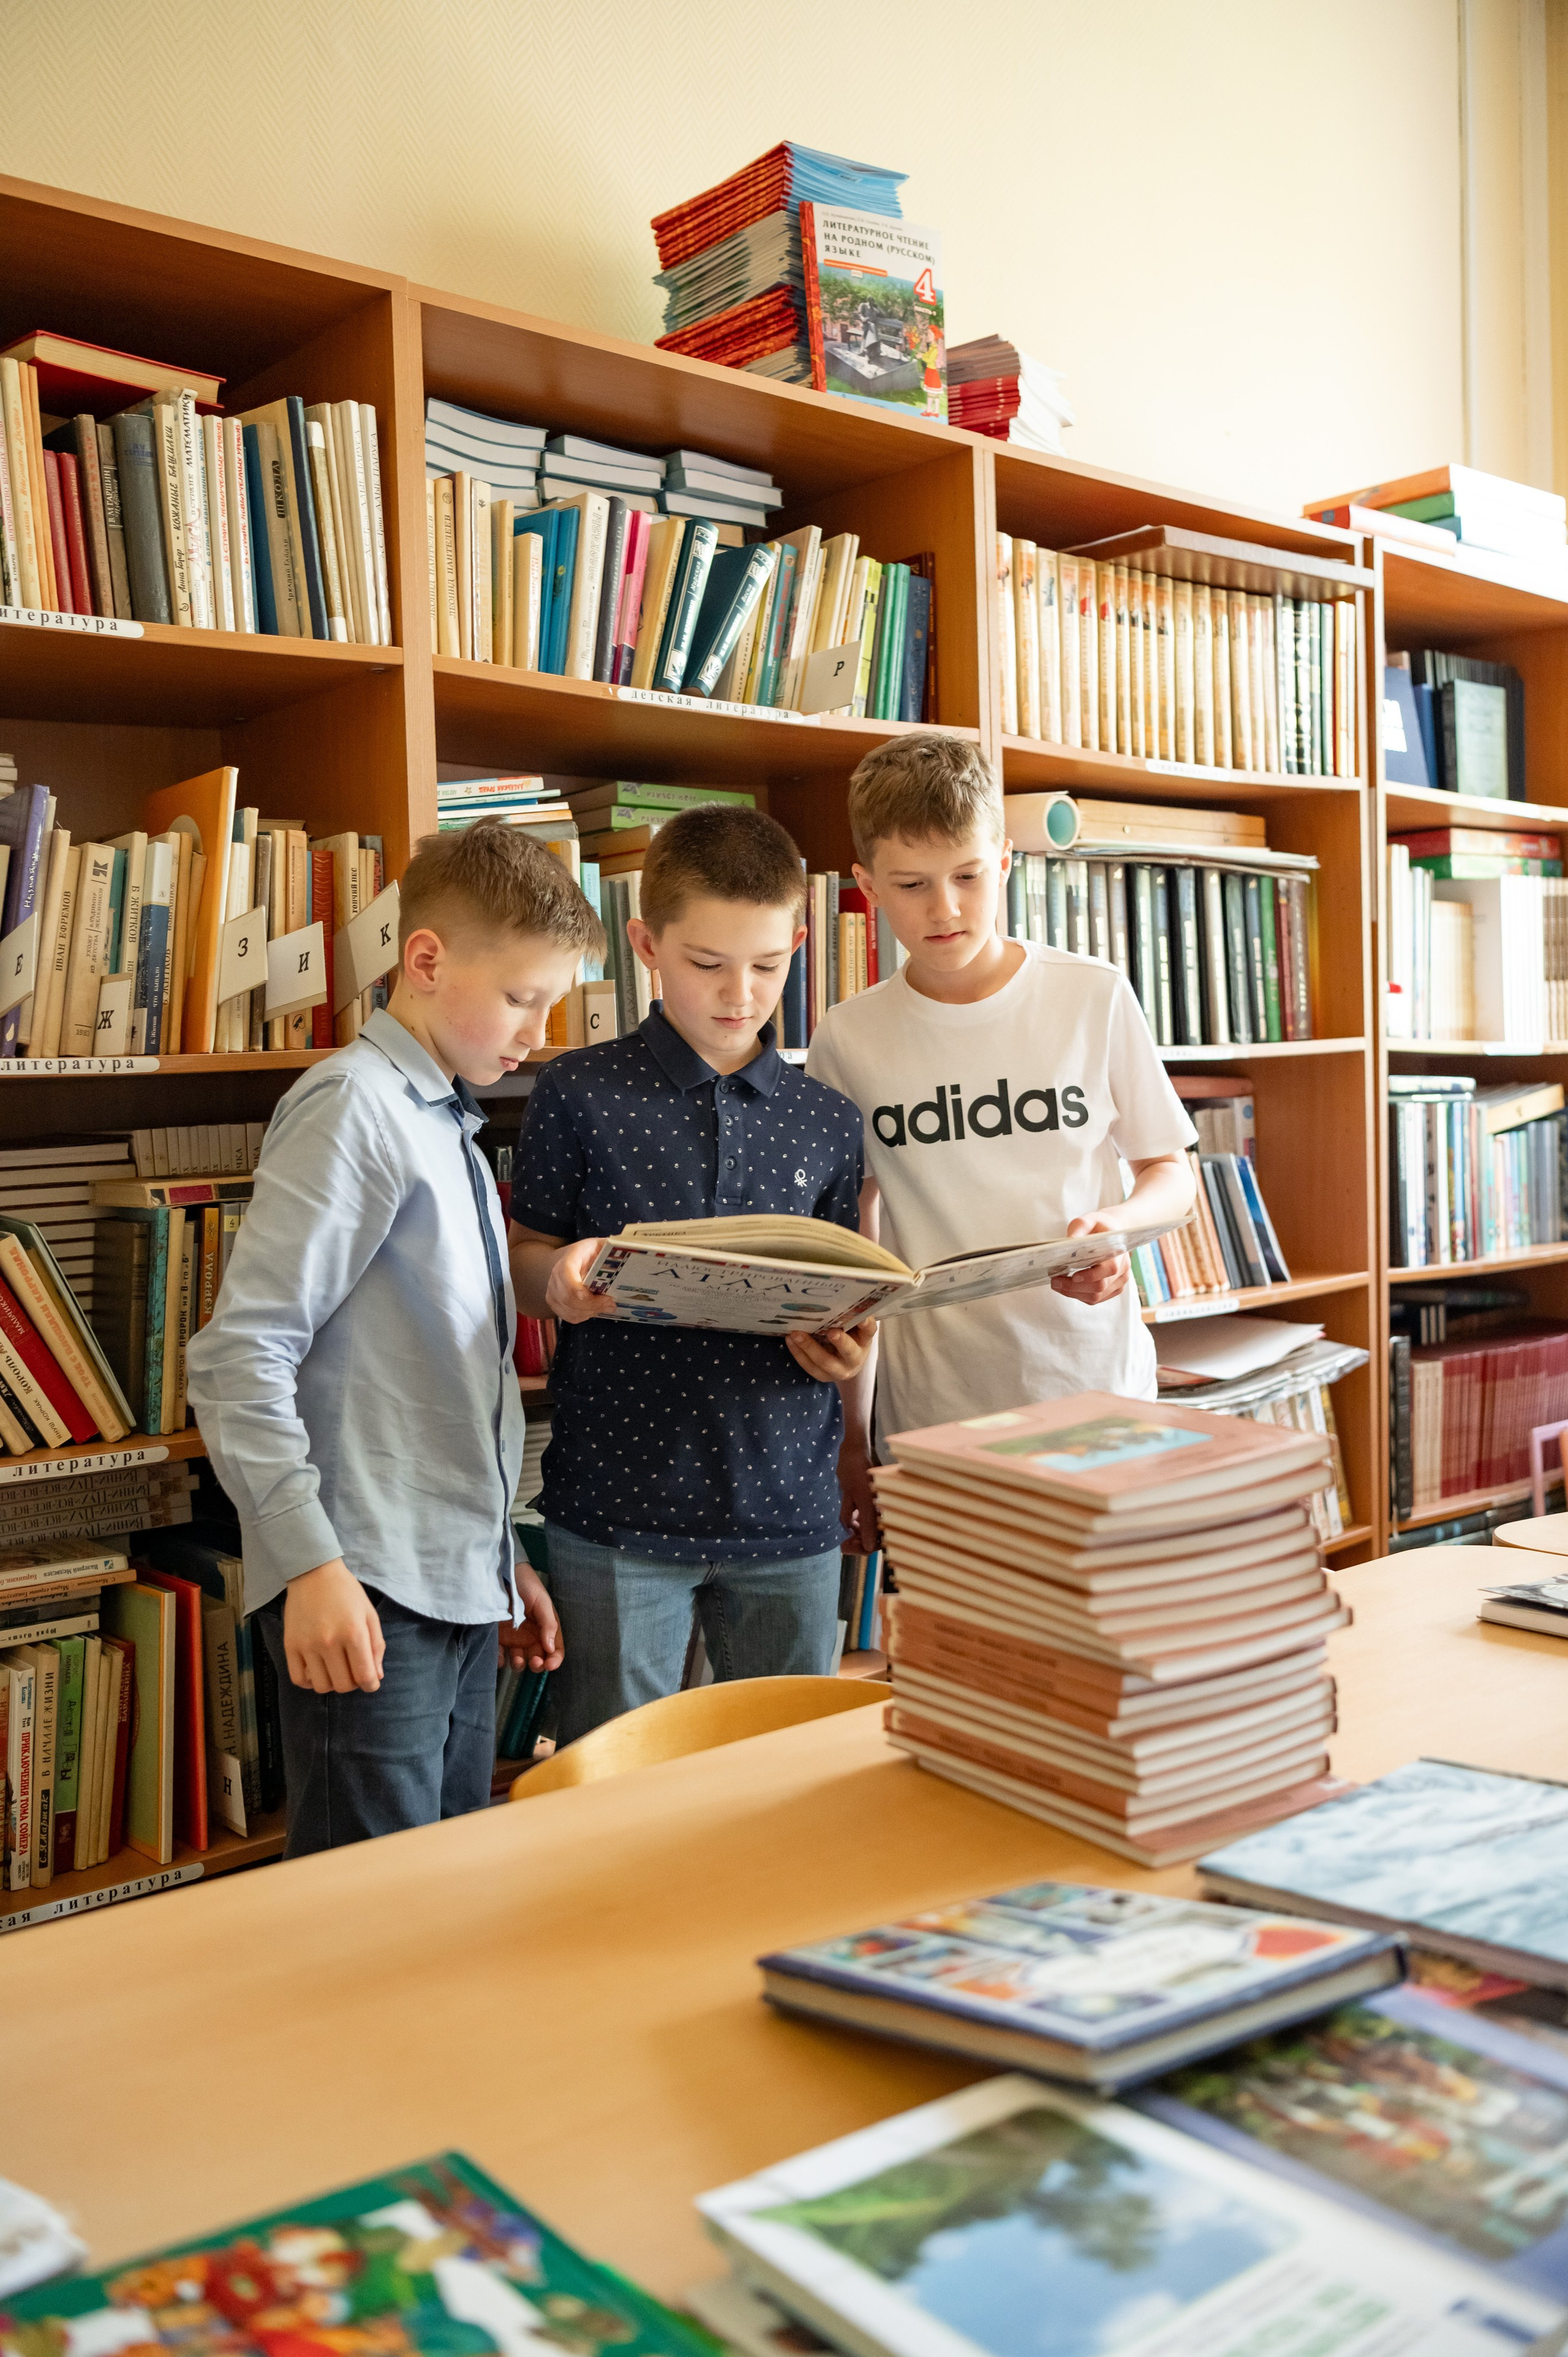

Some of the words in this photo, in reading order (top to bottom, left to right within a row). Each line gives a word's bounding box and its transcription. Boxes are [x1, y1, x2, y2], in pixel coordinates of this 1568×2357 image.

[823, 221, 894, 241] ЛИТЕРАТУРНОЕ
[897, 235, 929, 250] ЧТЕНИЕ
[824, 232, 837, 241] НА
[842, 235, 883, 250] РОДНОМ
[887, 246, 935, 265] (РУССКОМ)
[825, 245, 861, 257] ЯЗЫКЕ
[914, 268, 937, 305] 4
[181, 393, 194, 468] МАТЕМАТИКИ
[164, 426, 177, 478] БАШМАКИ
[355, 430, 364, 475] ПАРУСА
[370, 432, 380, 475] ПАРУСА
[104, 469, 114, 505] ГАРШИН
[273, 463, 285, 518] ШКОЛА
[170, 483, 181, 532] КОЖАНЫЕ
[176, 549, 185, 571] Гарф
[445, 515, 453, 575] ПАНТЕЛЕЕВ
[588, 512, 602, 583] РАССКАЗЫ
[178, 571, 186, 593] Анна
[690, 561, 701, 591] Мирская
[447, 579, 456, 619] ЛЕОНИД
[833, 661, 844, 676] Р
[631, 690, 692, 706] детская
[706, 700, 789, 720] литература
[132, 885, 140, 899] Б.
[59, 891, 71, 937] ЕФРЕМОВ
[129, 901, 139, 943] ЖИТКОВ
[238, 937, 249, 957] З
[380, 922, 391, 947] К
[15, 953, 23, 976] Е
[55, 938, 66, 971] ИВАН
[298, 951, 311, 973] И
[97, 1010, 115, 1030] Ж
[590, 1013, 599, 1030] С
[1, 1058, 134, 1073] литература
[872, 1078, 1088, 1148] adidas
[9, 1246, 45, 1303] КАРРОНАД
[203, 1251, 215, 1314] КЭРРОЛЛ
[649, 1268, 840, 1297] АТЛАС
[1, 1298, 26, 1335] МАЛЬЧИК
[179, 1311, 187, 1348] ПРОРОК
[5, 1356, 34, 1395] КОРОЛЬ
[74, 1363, 91, 1387] ТРОЕ
[34, 1399, 50, 1422] КОРЧАК
[49, 1422, 63, 1440] ЯНУШ
[13, 1449, 145, 1477] литература
[43, 1567, 72, 1578] Медведев
[73, 1564, 98, 1574] Валерий
[36, 1628, 57, 1637] Юрий
[43, 1672, 54, 1714] ЖИЗНИ
[42, 1718, 53, 1764] НАЧАЛЕ
[20, 1732, 31, 1797] ПРИКЛЮЧЕНИЯ
[224, 1776, 232, 1796] Н
[20, 1797, 29, 1822] ТОМА
[19, 1823, 31, 1856] СОЙЕРА
[53, 1870, 181, 1915] литература
